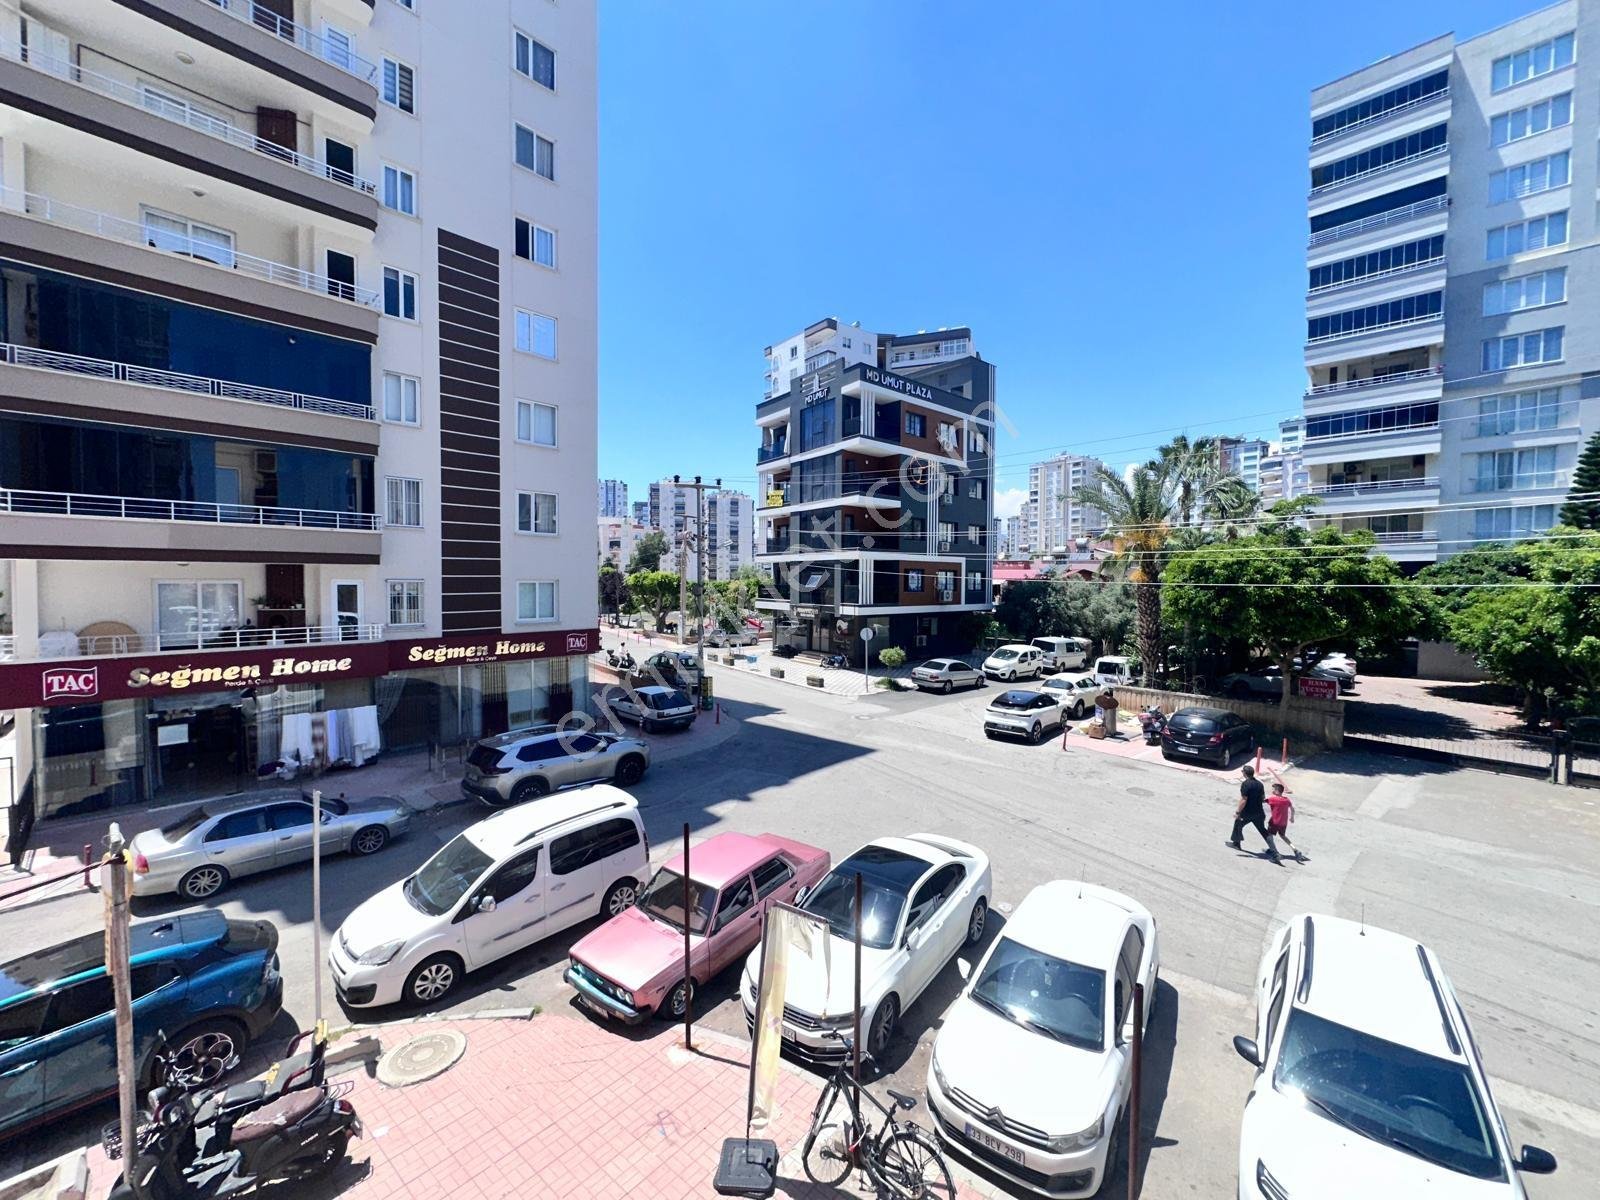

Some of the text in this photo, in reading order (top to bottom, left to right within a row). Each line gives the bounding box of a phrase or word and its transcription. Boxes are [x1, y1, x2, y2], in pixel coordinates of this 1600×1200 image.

[866, 369, 932, 400] MD UMUT PLAZA
[805, 388, 828, 404] MD UMUT
[408, 640, 546, 663] Seğmen Home
[569, 636, 586, 648] TAC
[47, 673, 94, 692] TAC
[127, 657, 352, 689] Seğmen Home
[1004, 1146, 1022, 1161] 298
